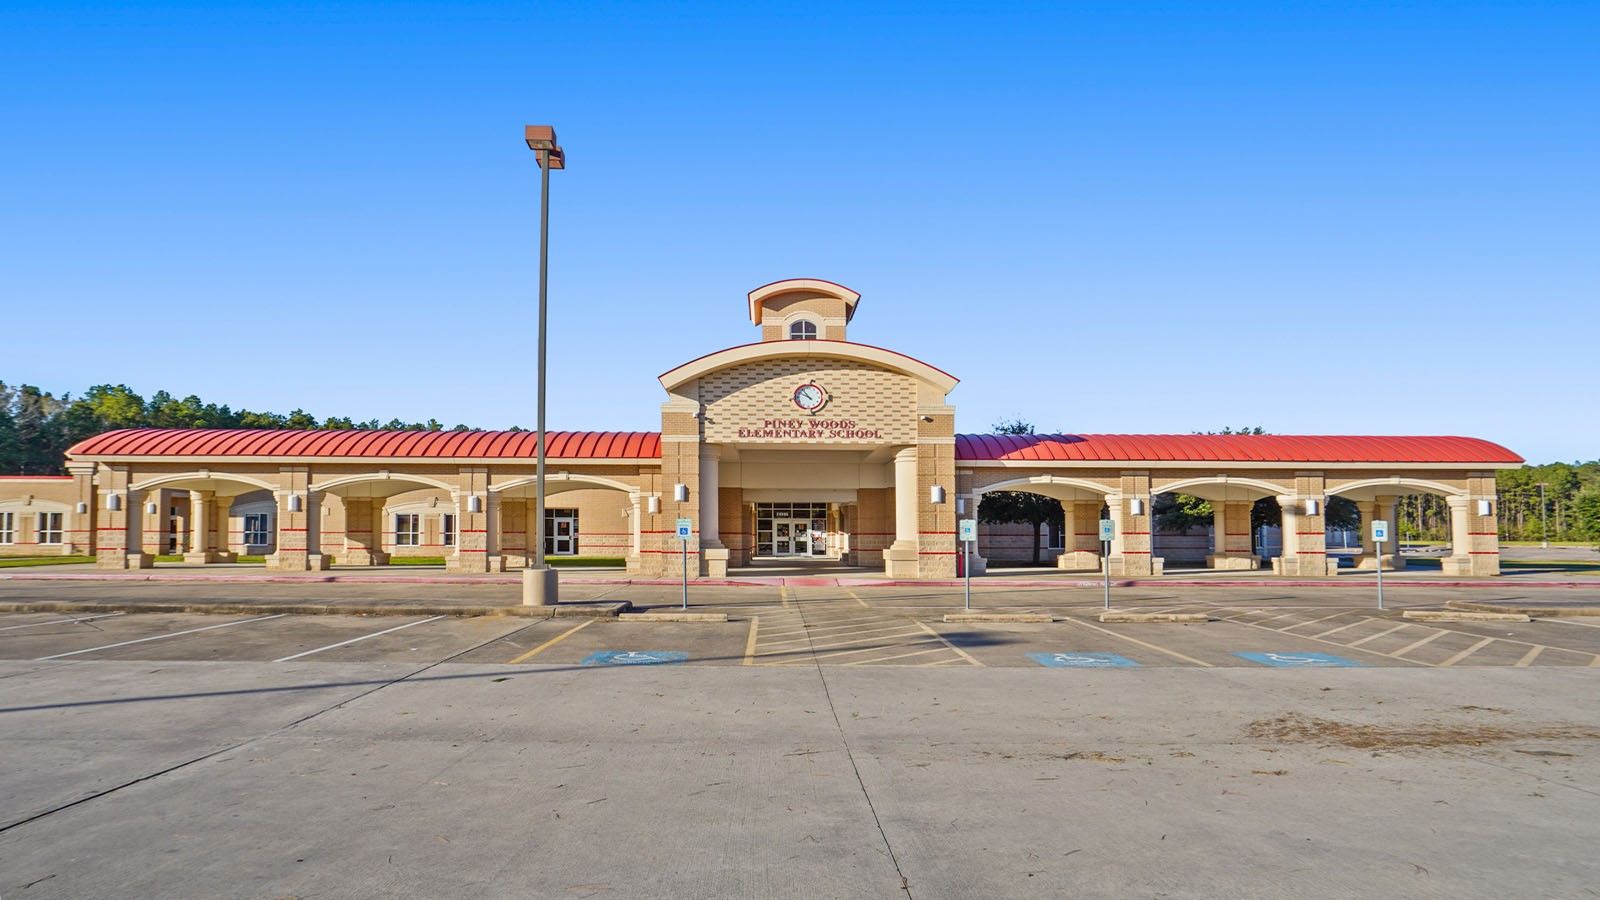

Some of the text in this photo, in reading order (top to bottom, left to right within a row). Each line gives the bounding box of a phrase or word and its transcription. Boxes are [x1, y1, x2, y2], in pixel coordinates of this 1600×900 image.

[764, 419, 856, 429] PINEY WOODS
[738, 429, 882, 438] ELEMENTARY SCHOOL
